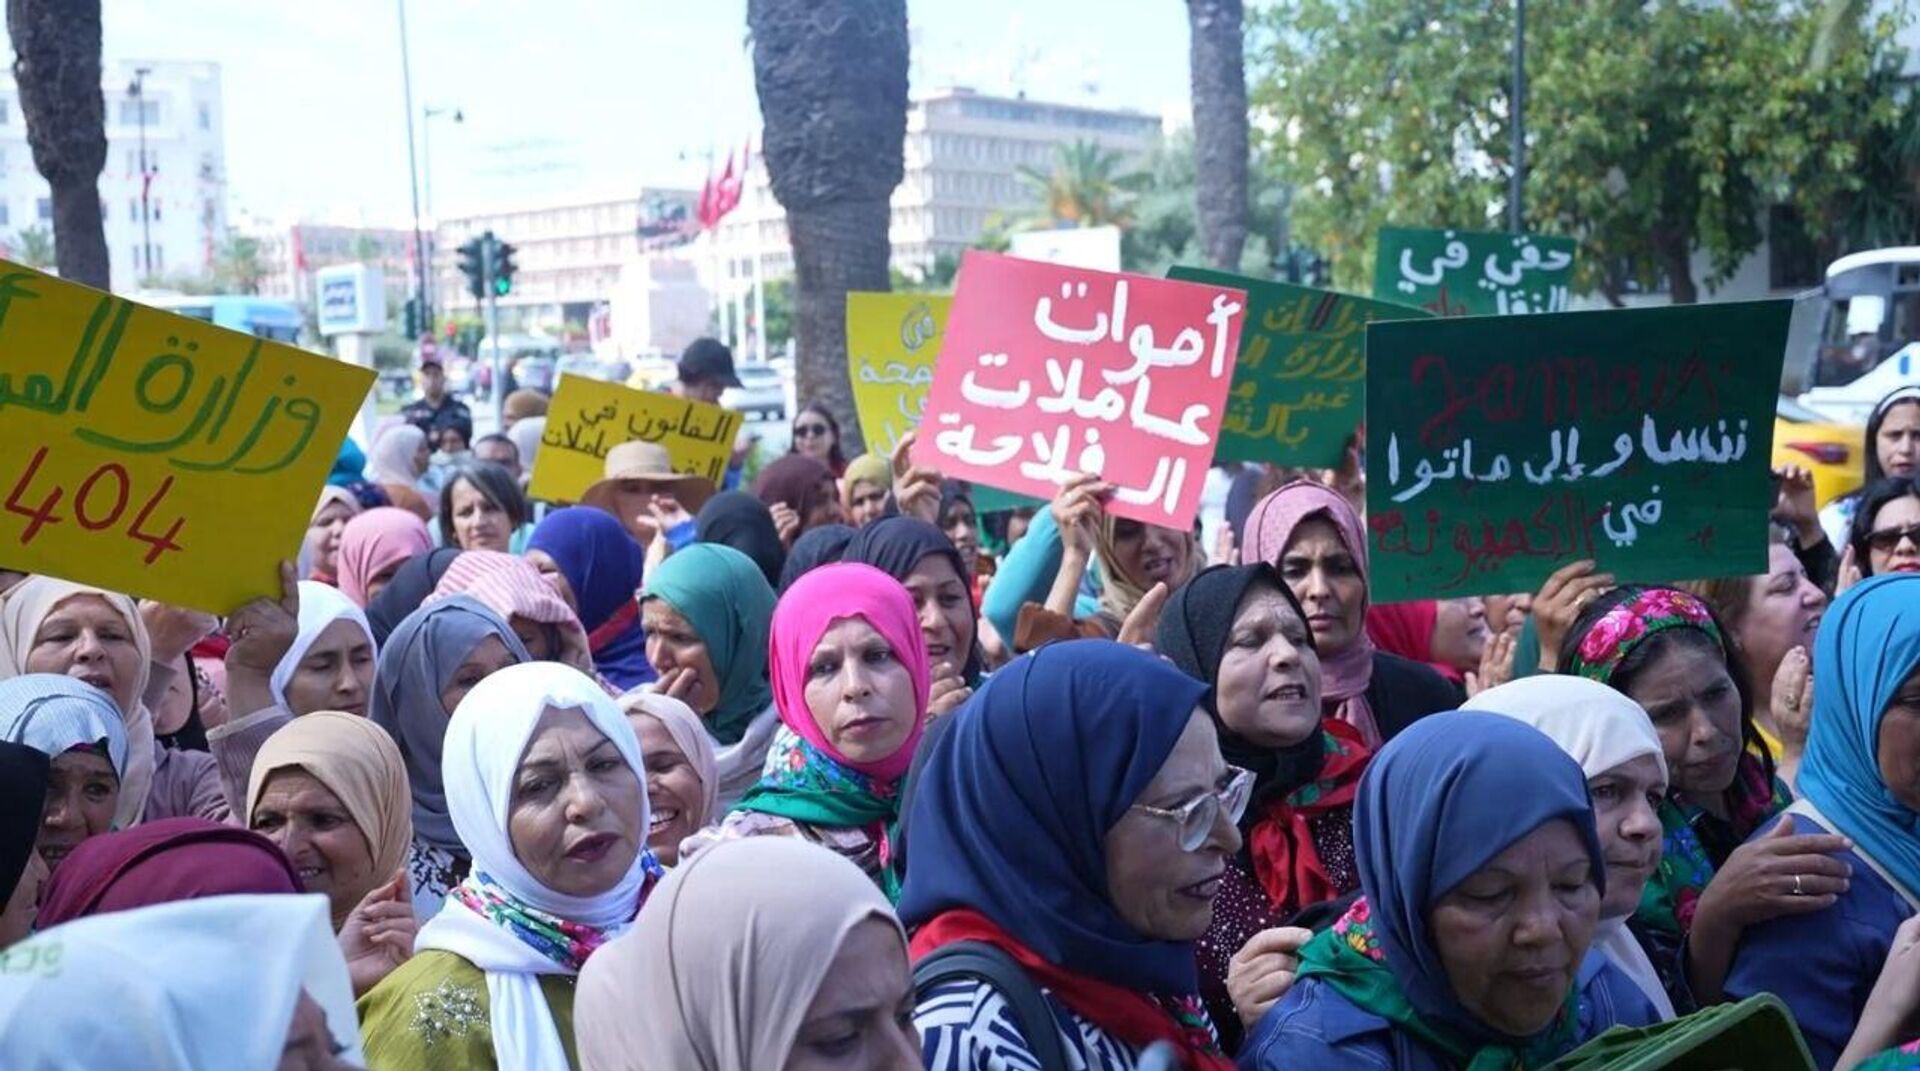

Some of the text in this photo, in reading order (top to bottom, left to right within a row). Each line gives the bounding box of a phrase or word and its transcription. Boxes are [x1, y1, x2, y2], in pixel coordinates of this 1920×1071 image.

[1397, 230, 1572, 293] حقي في
[75, 334, 321, 474] وزارة
[627, 403, 732, 445] القانون
[961, 353, 1211, 445] عاملات
[1387, 432, 1512, 502] ماتوا
[4, 446, 187, 566] 404
[1602, 485, 1662, 548] في
